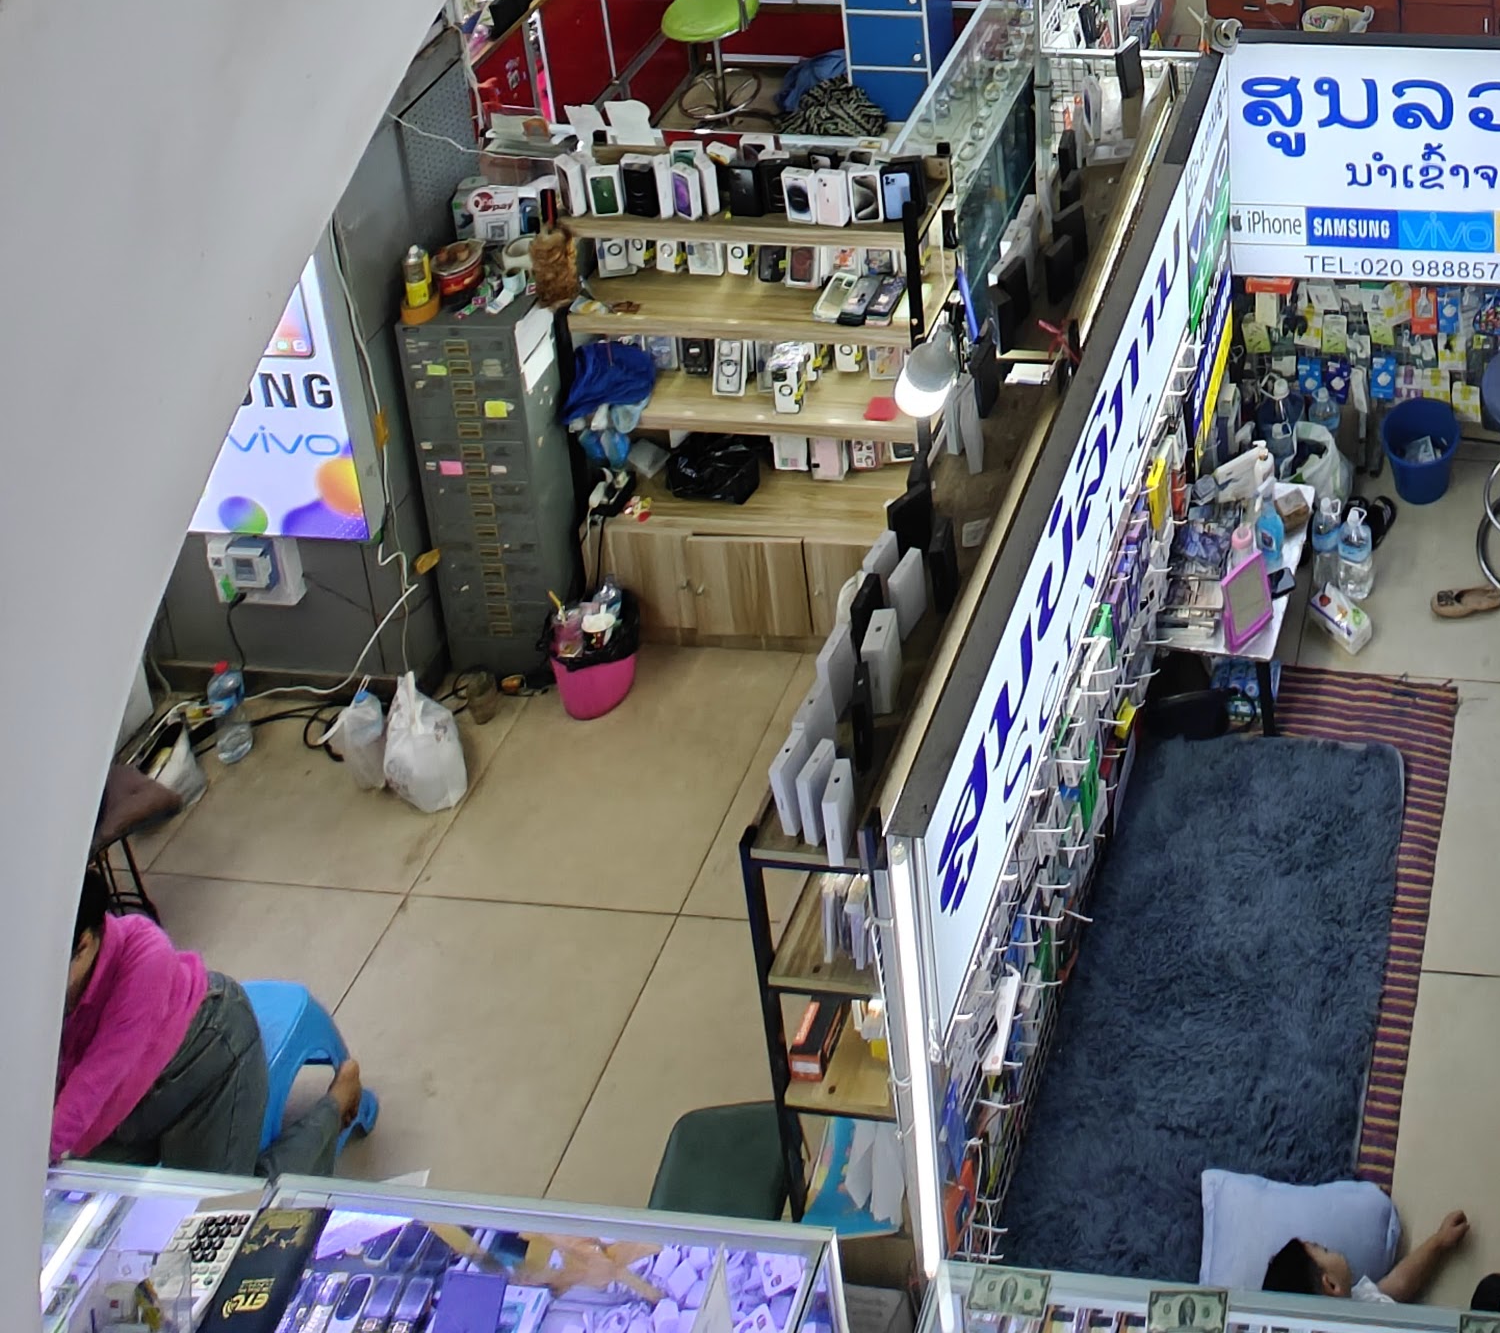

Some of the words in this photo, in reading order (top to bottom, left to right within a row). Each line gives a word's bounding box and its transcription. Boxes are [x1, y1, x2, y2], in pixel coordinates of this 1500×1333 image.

[1246, 213, 1302, 237] iPhone
[1312, 218, 1391, 241] SAMSUNG
[1402, 211, 1494, 251] vivo
[1306, 253, 1404, 278] TEL:020
[229, 424, 341, 457] vivo
[1003, 391, 1153, 844] Service
